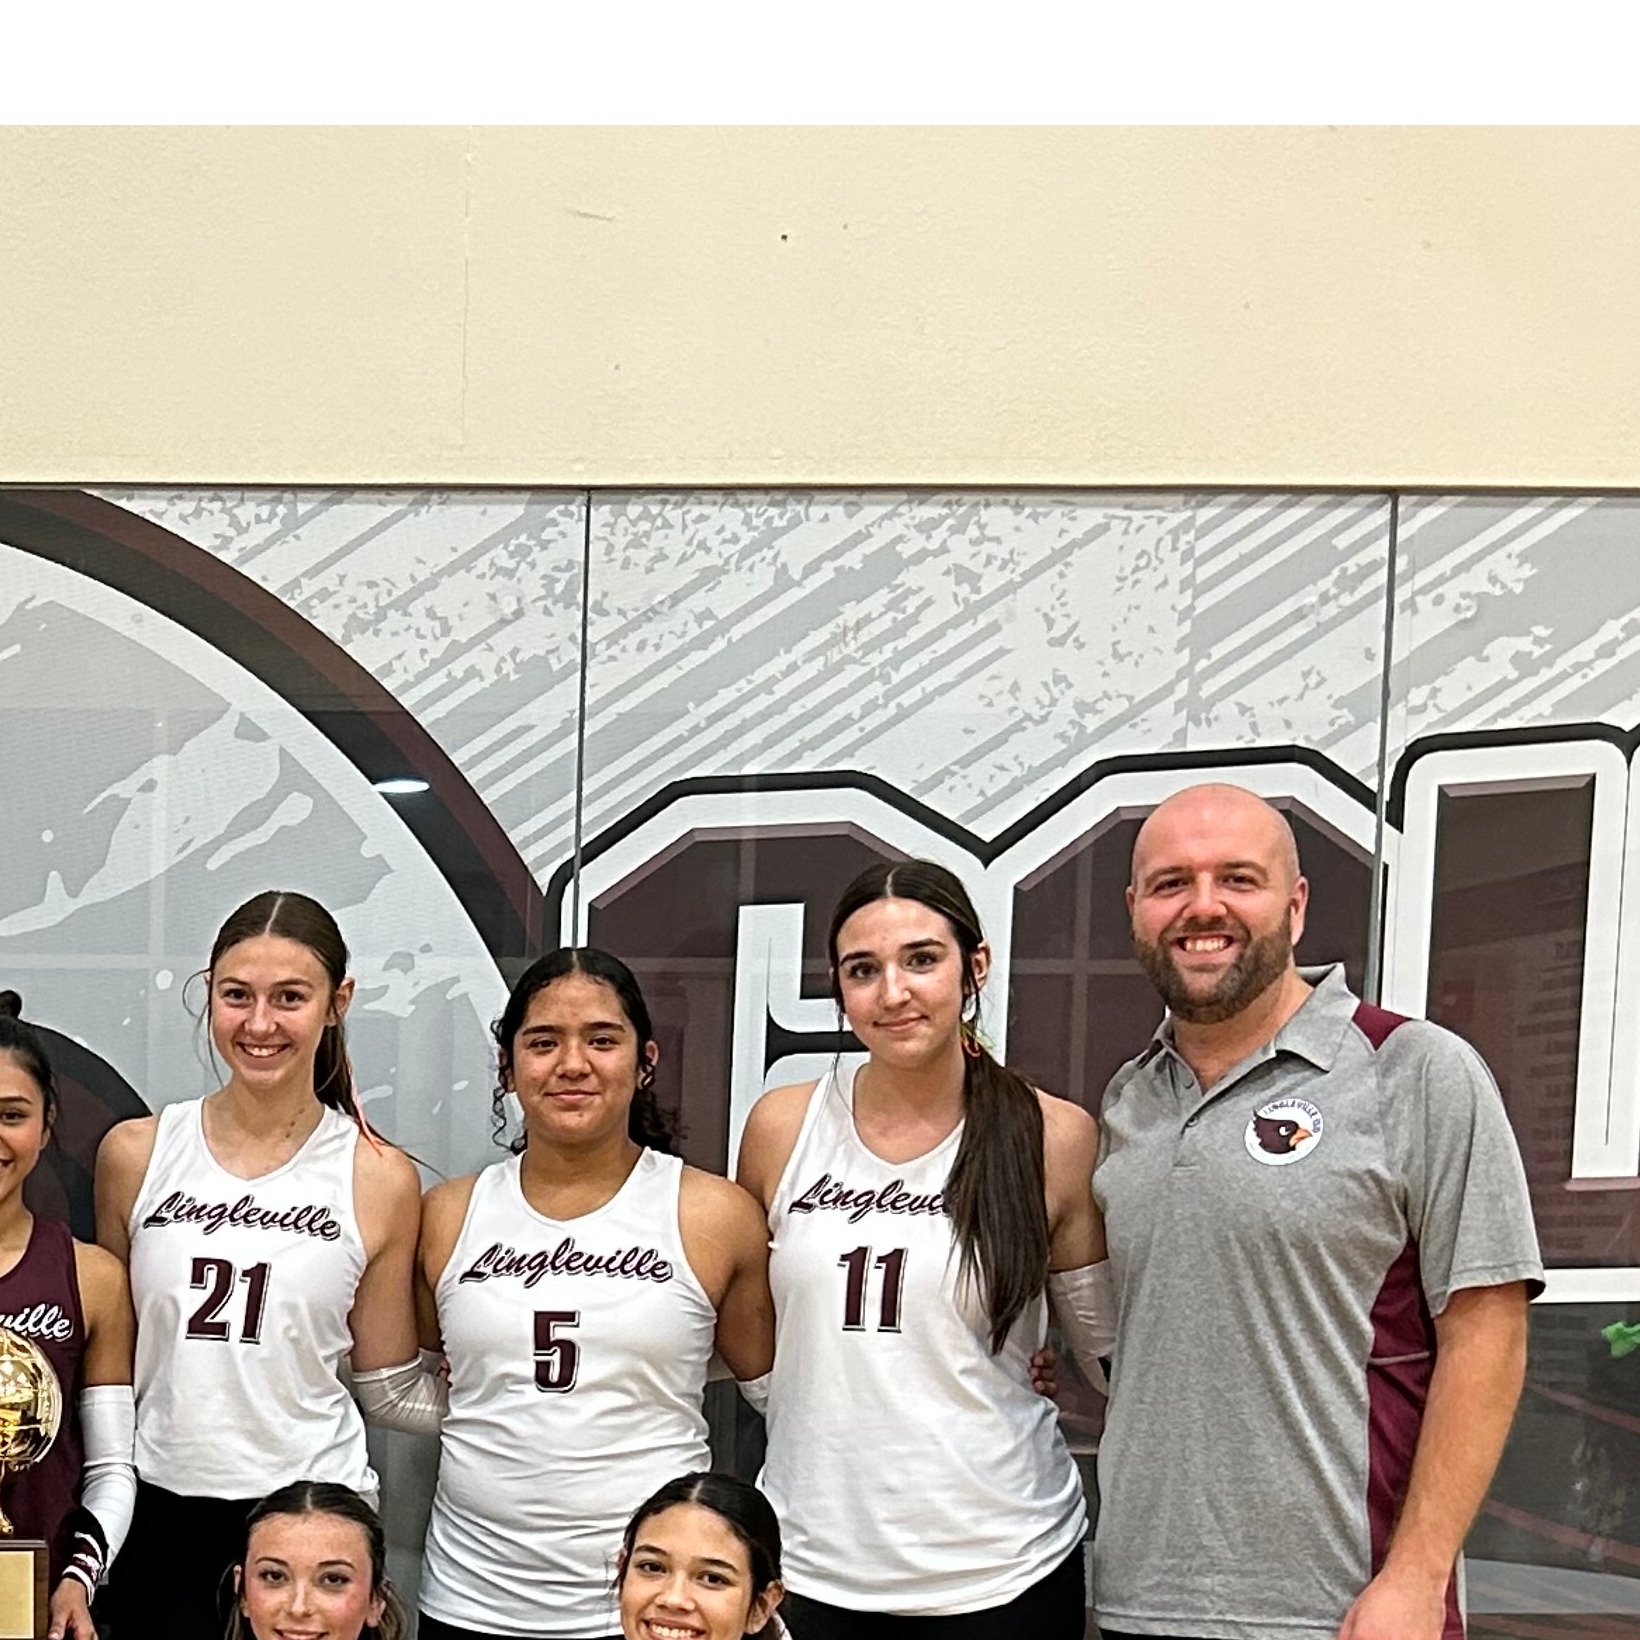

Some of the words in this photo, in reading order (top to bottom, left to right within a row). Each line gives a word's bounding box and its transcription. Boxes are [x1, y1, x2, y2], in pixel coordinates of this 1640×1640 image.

[143, 1190, 342, 1241] Lingleville
[186, 1256, 272, 1345] 21
[459, 1237, 673, 1289] Lingleville
[837, 1245, 909, 1334] 11
[532, 1310, 581, 1394] 5
